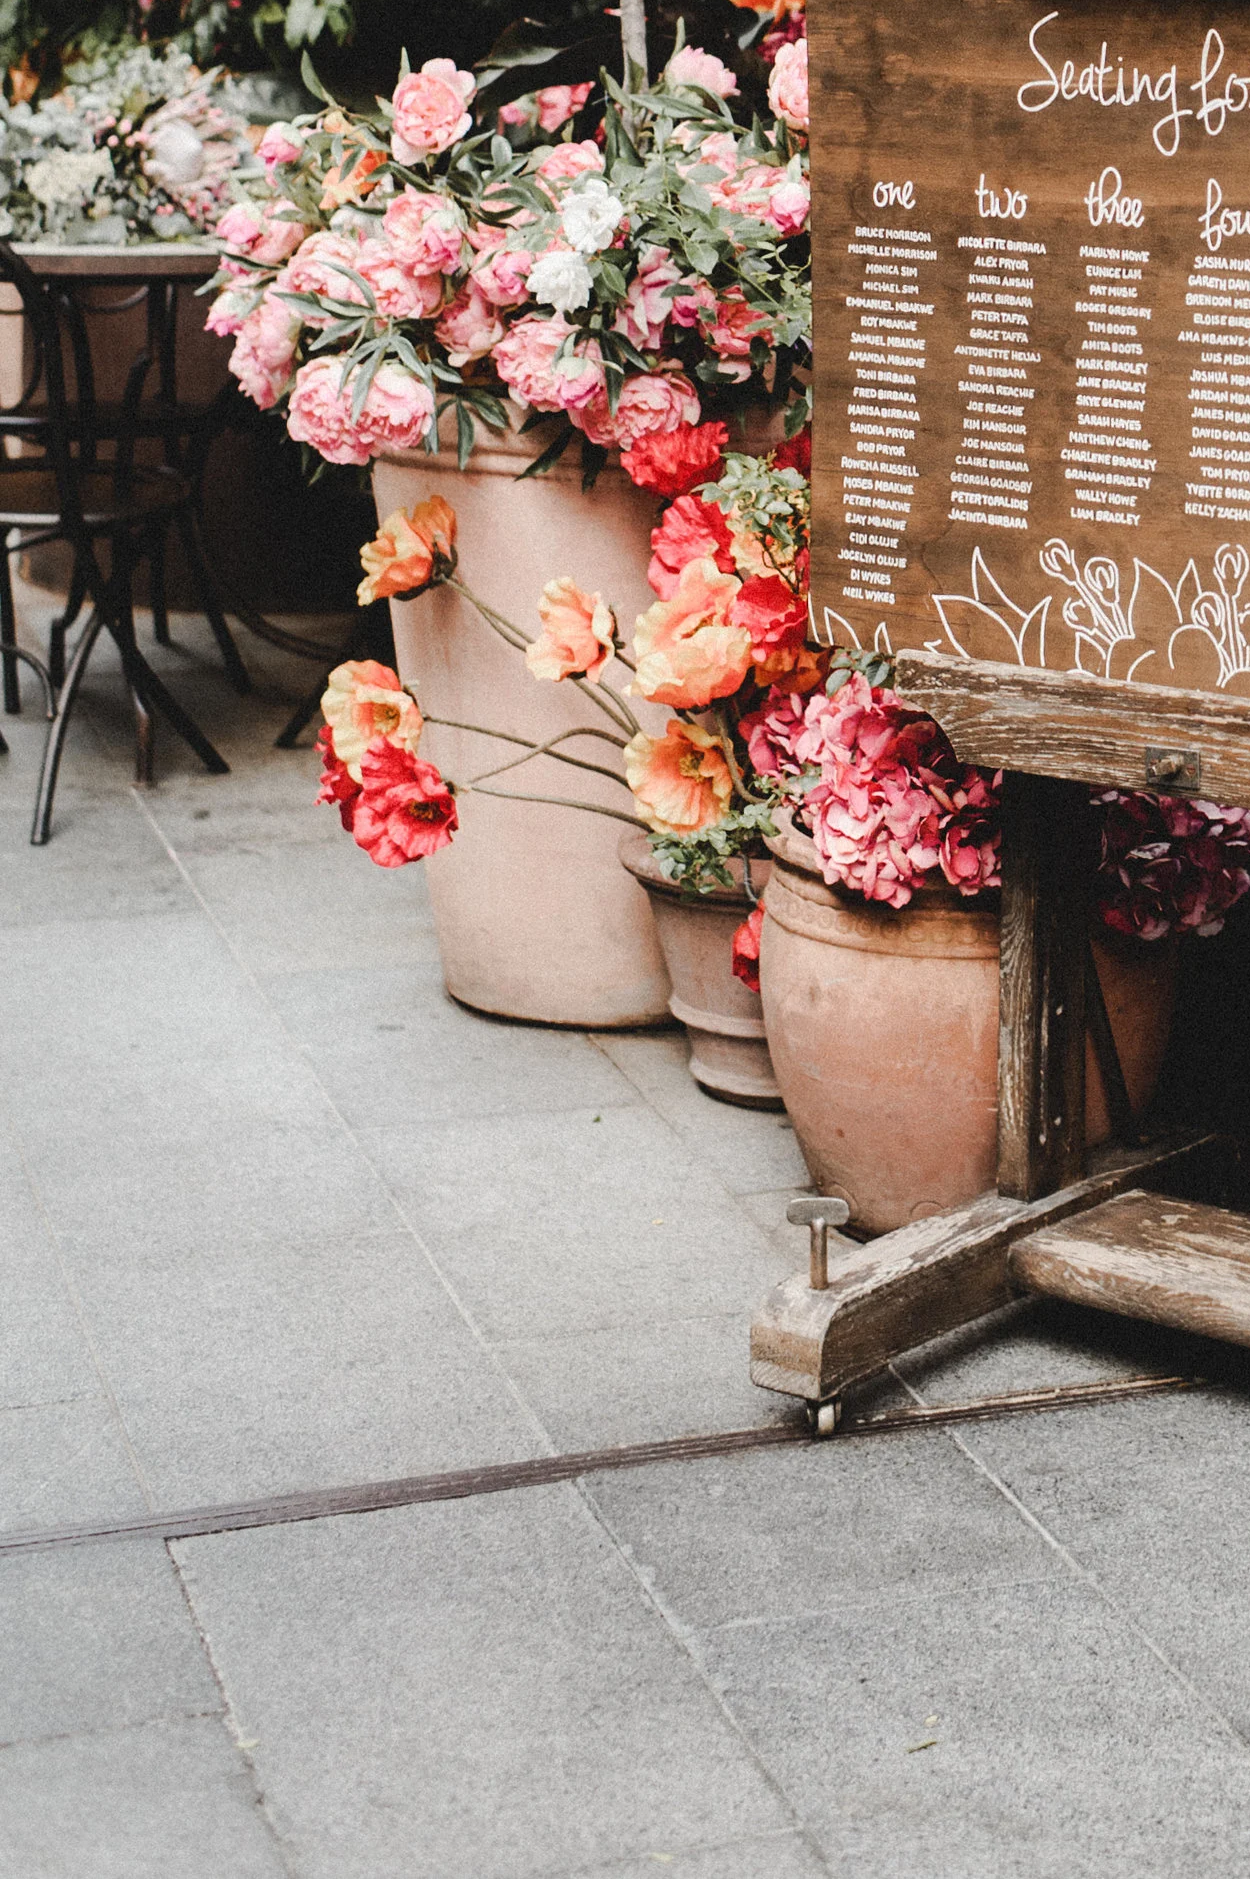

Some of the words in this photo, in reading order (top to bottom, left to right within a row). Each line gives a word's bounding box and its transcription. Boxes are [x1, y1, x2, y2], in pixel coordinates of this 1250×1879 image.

[1017, 11, 1193, 156] Seating
[873, 179, 916, 209] one
[975, 173, 1028, 219] two
[1084, 166, 1145, 228] three
[855, 227, 884, 239] BRUCE
[886, 229, 931, 242] MORRISON
[848, 244, 890, 255] MICHELLE
[892, 247, 937, 260] MORRISON
[974, 256, 997, 267] ALEX
[999, 258, 1029, 271] PRYOR
[1194, 256, 1228, 269] SASHA
[866, 264, 899, 275] MONICA
[901, 266, 918, 277] SIM
[863, 282, 901, 293] MICHAEL
[903, 285, 918, 294] SIM
[1188, 275, 1227, 290] GARETH
[967, 292, 993, 303] MARK
[1090, 285, 1107, 296] PAT
[1108, 286, 1138, 297] MUSIC
[971, 310, 1000, 322] PETER
[970, 328, 1000, 340] GRACE
[1087, 322, 1106, 333] TIM
[1107, 324, 1137, 335] BOOTS
[1201, 352, 1222, 363] LUIS
[1076, 358, 1104, 369] MARK
[1105, 360, 1148, 374] BRADLEY
[1191, 407, 1224, 419] JAMES
[850, 423, 884, 436] SANDRA
[886, 427, 915, 439] PRYOR
[963, 418, 980, 430] KIM
[982, 422, 1027, 434] MANSOUR
[1192, 427, 1221, 439] DAVID
[961, 438, 979, 448] JOE
[981, 441, 1025, 453] MANSOUR
[1069, 431, 1116, 446] MATTHEW
[857, 442, 875, 452] BOB
[876, 443, 905, 456] PRYOR
[841, 456, 879, 470] ROWENA
[880, 463, 919, 476] RUSSELL
[955, 456, 988, 467] CLAIRE
[1061, 449, 1111, 465] CHARLENE
[1112, 456, 1157, 471] BRADLEY
[1200, 466, 1222, 478] TOM
[1075, 489, 1107, 502] WALLY
[1108, 493, 1137, 506] HOWE
[1185, 483, 1223, 498] YVETTE
[843, 494, 871, 507] PETER
[1071, 508, 1094, 520] LIAM
[1096, 511, 1140, 525] BRADLEY
[851, 569, 860, 580] DI
[861, 571, 891, 584] WYKES
[843, 587, 864, 599] NEIL
[865, 590, 895, 604] WYKES
